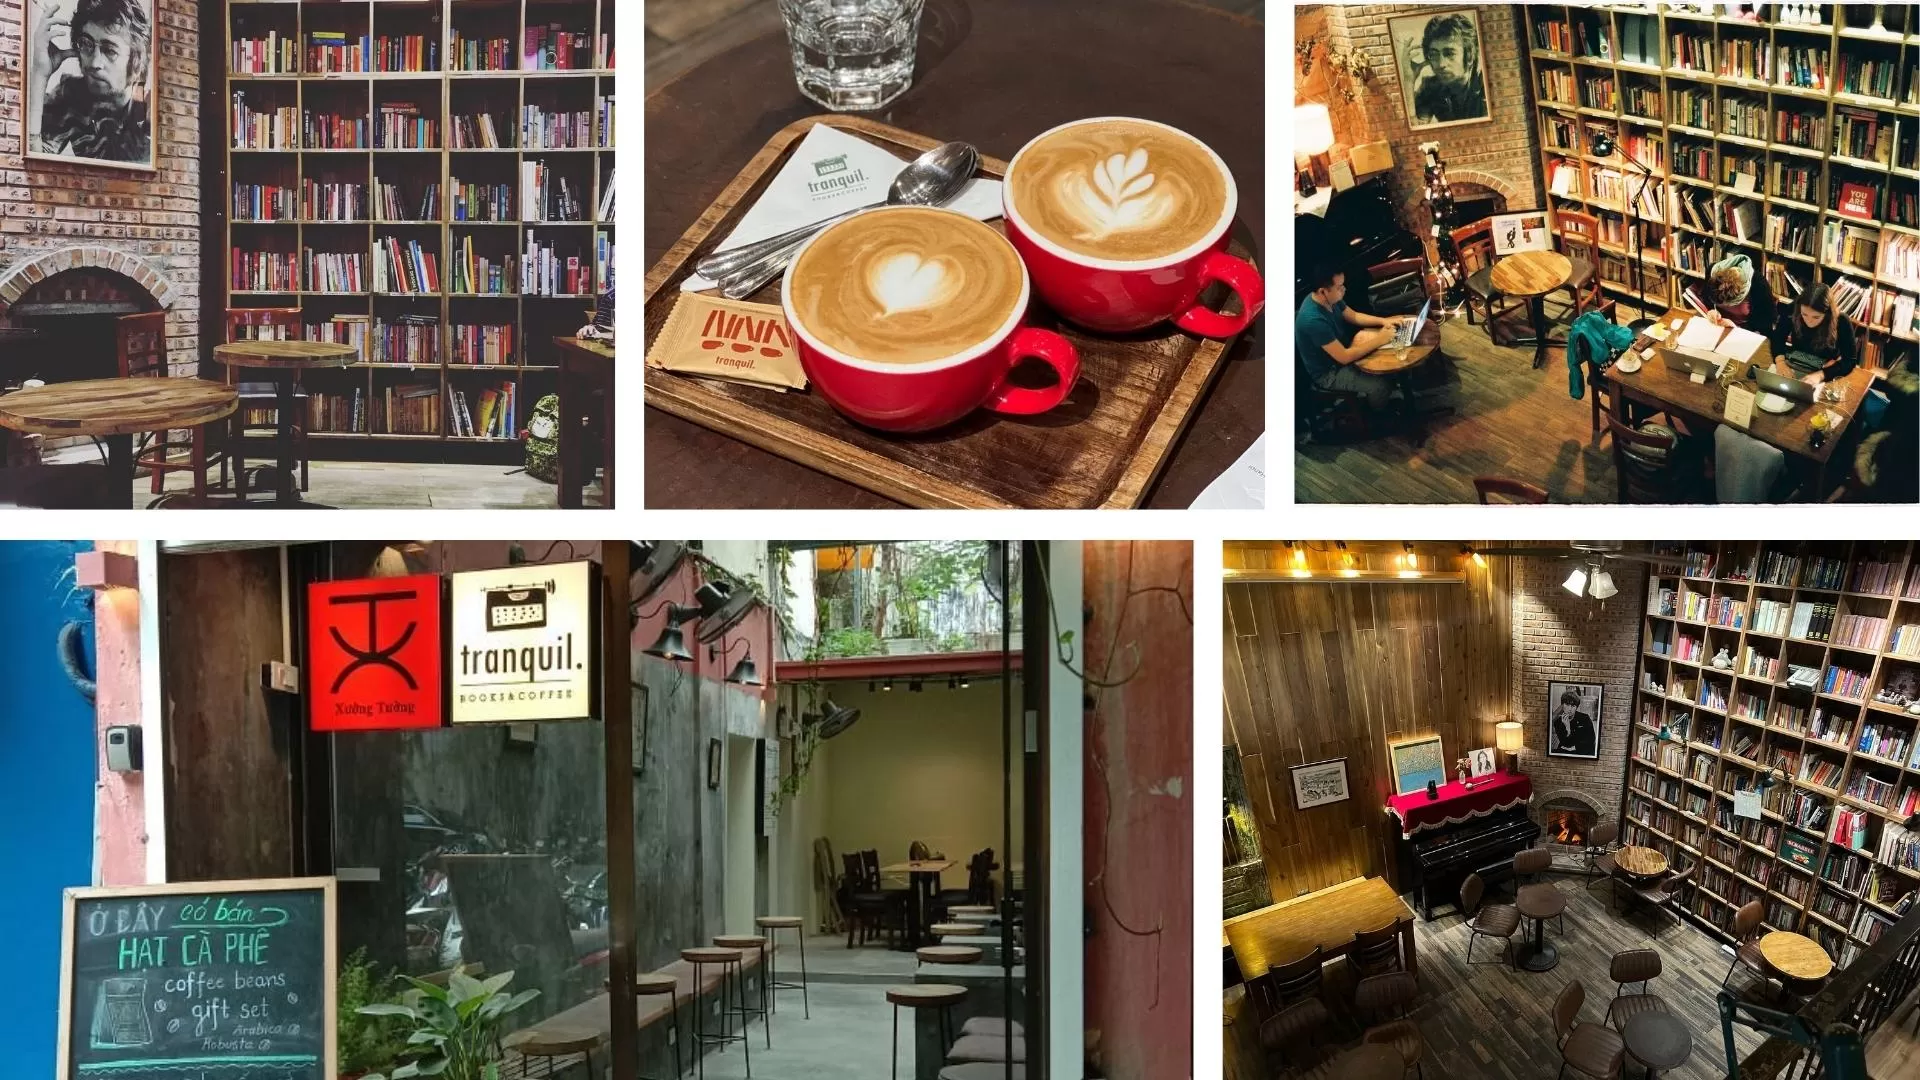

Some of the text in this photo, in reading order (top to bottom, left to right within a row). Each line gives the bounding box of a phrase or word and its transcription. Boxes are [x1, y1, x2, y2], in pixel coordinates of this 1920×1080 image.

[807, 169, 869, 193] tranquil.
[1848, 197, 1866, 206] ARE
[1850, 190, 1868, 200] YOU
[715, 356, 756, 369] tranquil.
[460, 632, 583, 683] tranquil.
[459, 689, 573, 704] BOOKS&COFFEE
[214, 898, 255, 922] bán
[182, 930, 212, 966] CÀ
[225, 927, 270, 965] PHÊ
[165, 969, 286, 999] coffee beans
[192, 996, 269, 1037] gift set
[232, 1021, 283, 1036] Arabica
